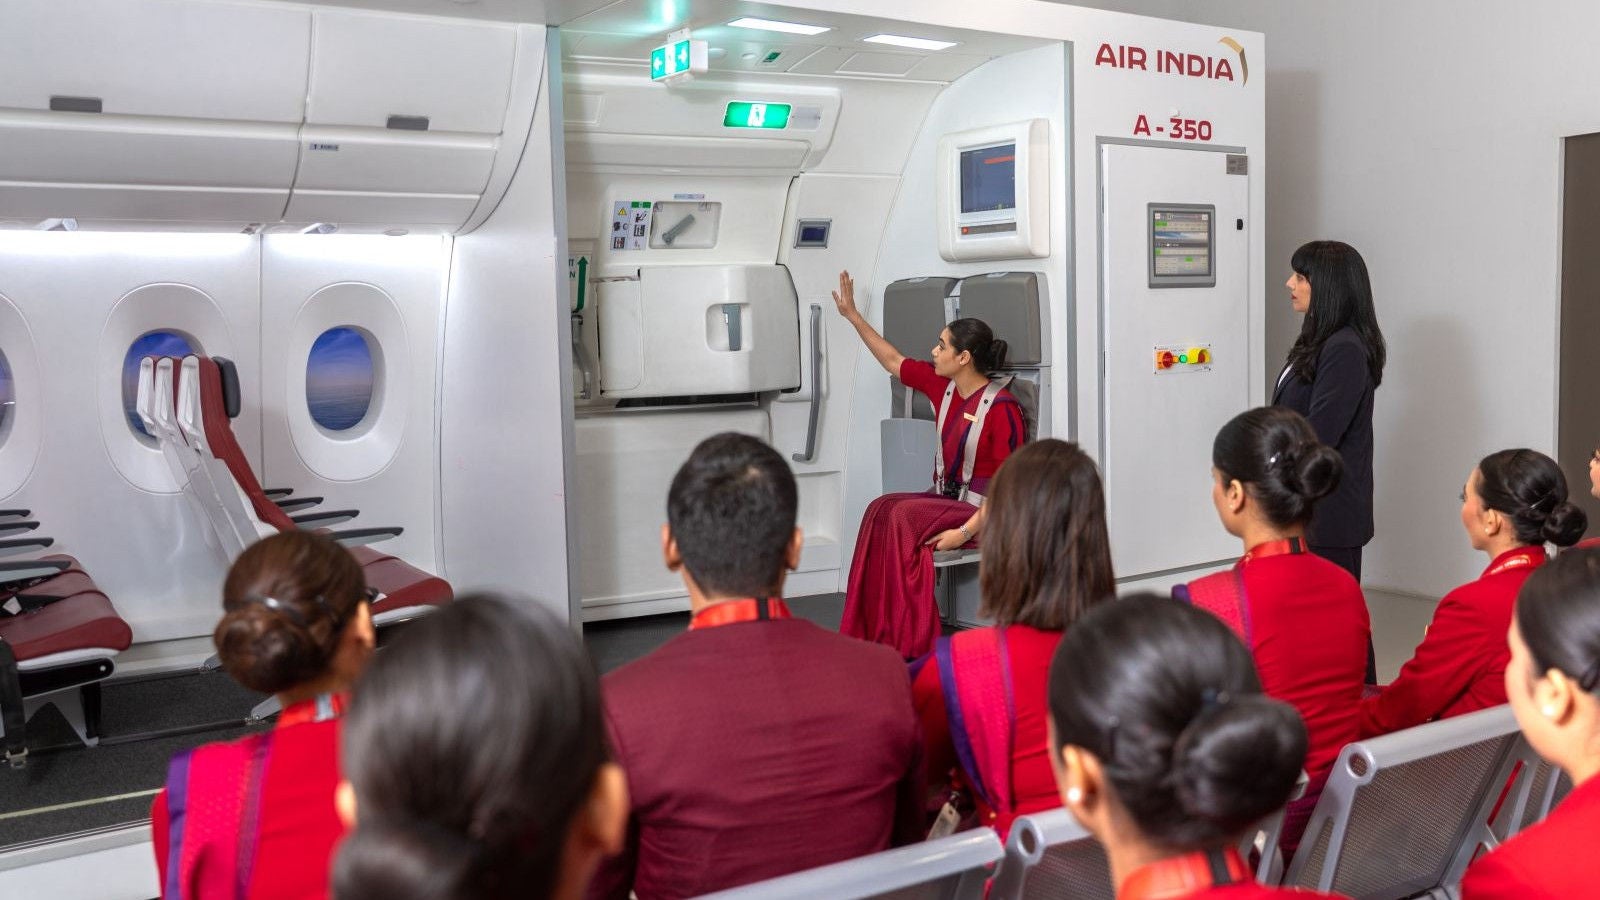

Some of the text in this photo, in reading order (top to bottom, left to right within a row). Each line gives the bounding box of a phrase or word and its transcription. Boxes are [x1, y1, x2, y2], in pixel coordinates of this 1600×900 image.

[1095, 43, 1234, 81] AIR INDIA
[1133, 114, 1152, 136] A
[1169, 117, 1213, 141] 350
